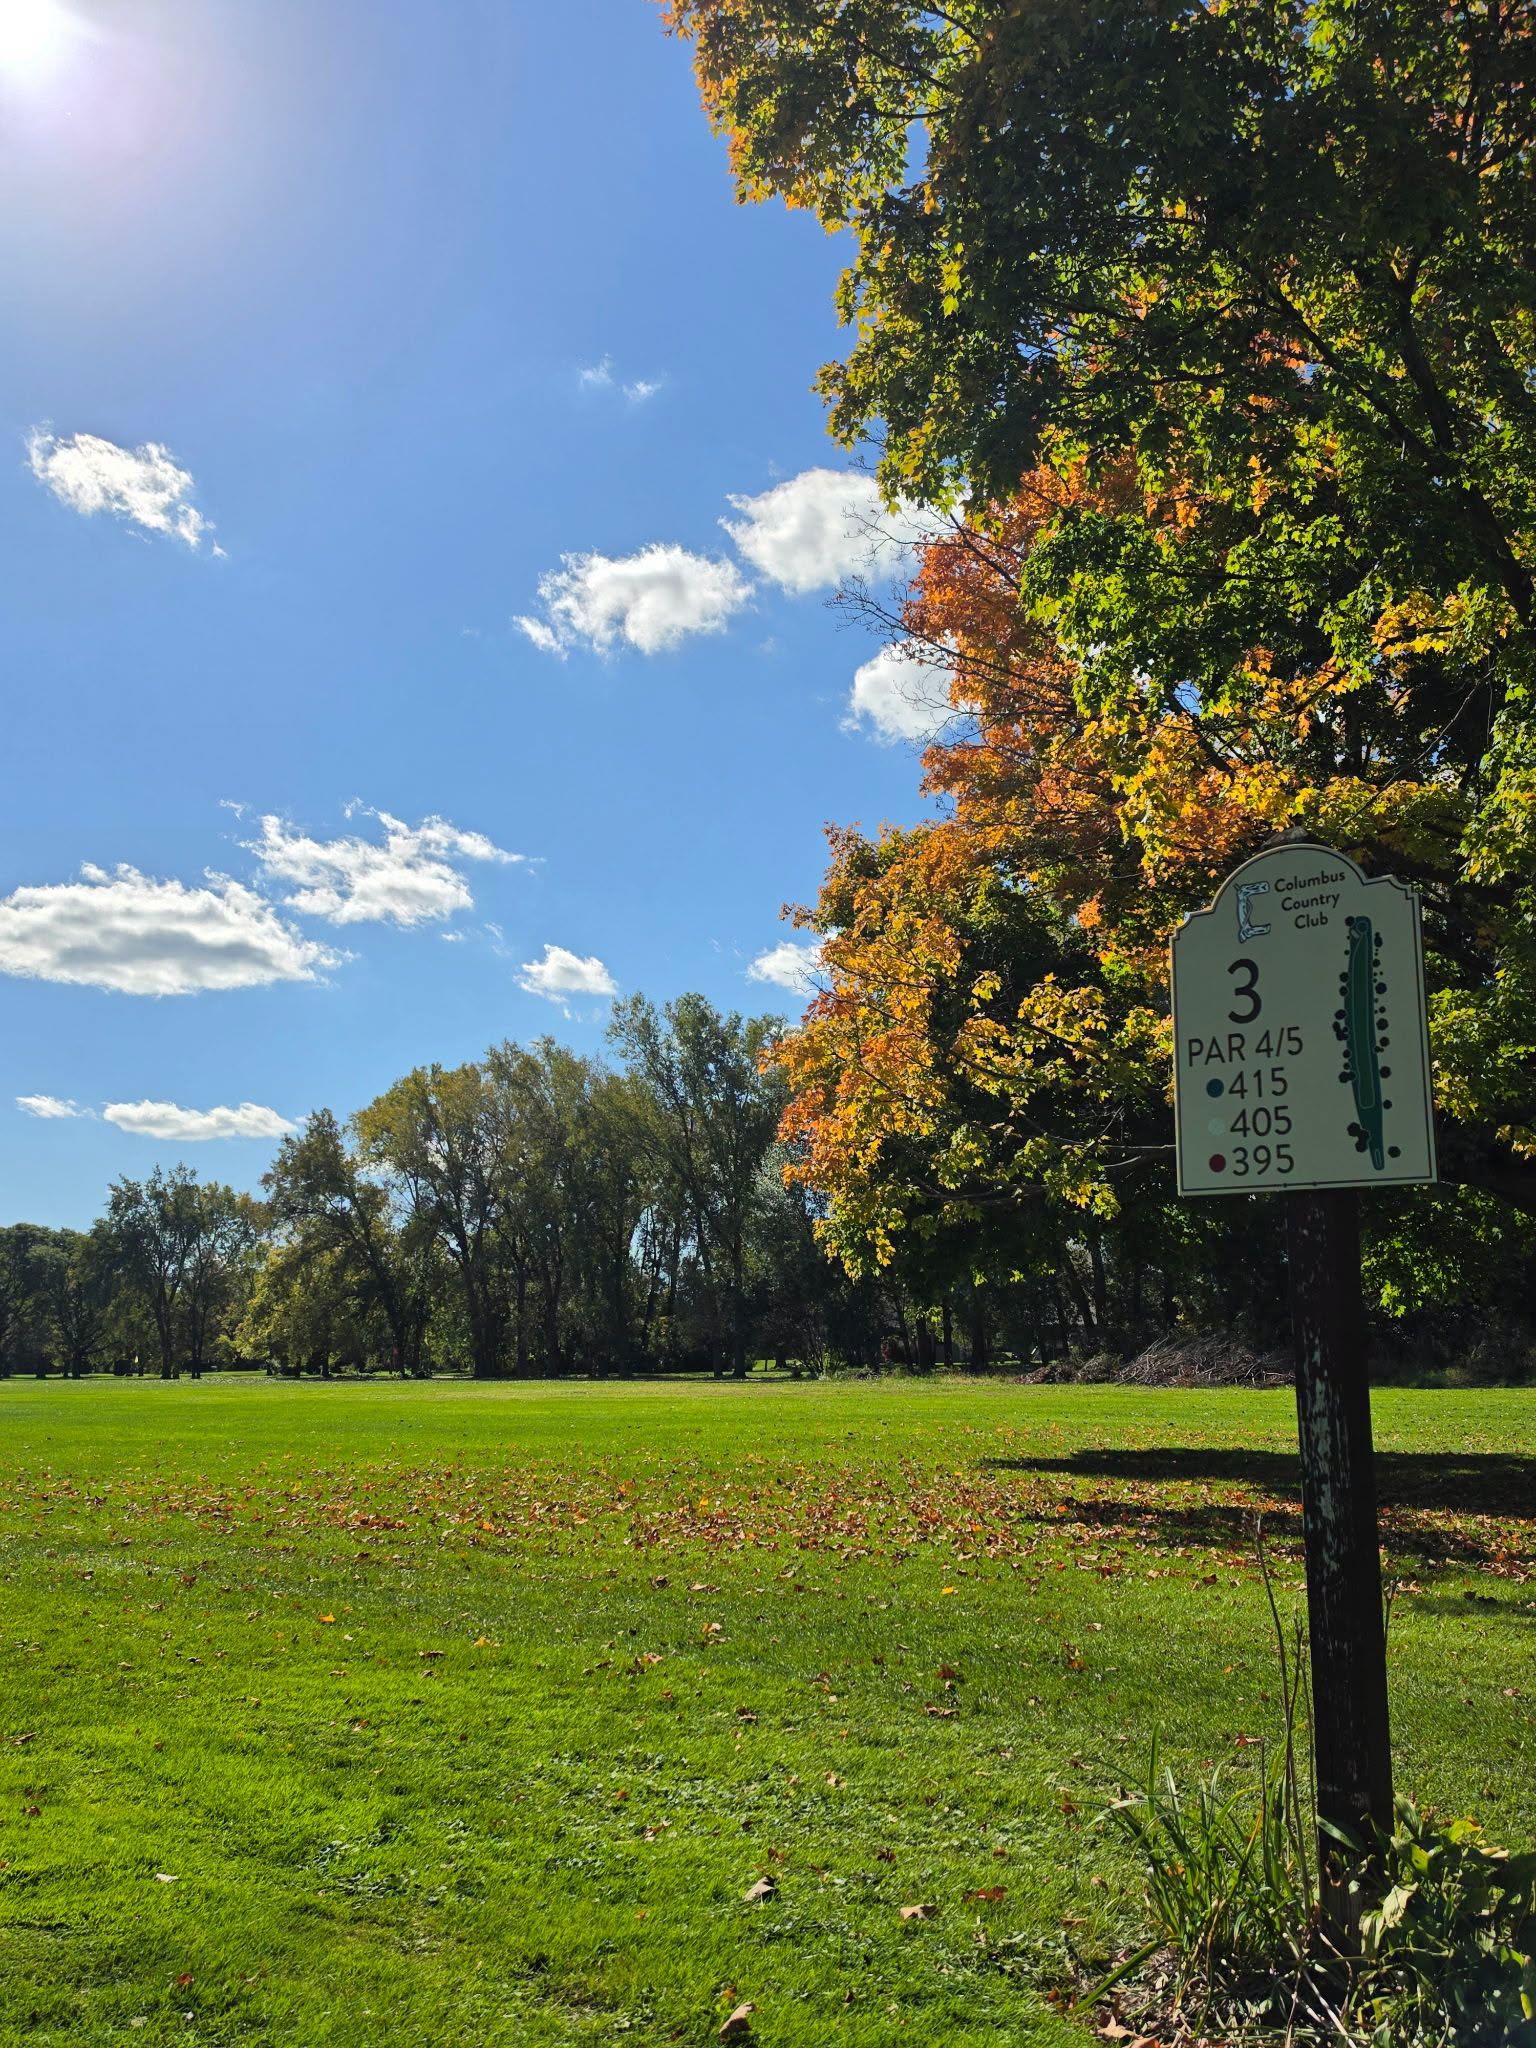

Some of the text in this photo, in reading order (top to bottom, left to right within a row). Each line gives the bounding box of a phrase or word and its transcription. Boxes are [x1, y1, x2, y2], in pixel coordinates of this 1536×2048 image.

[1274, 870, 1346, 892] Columbus
[1281, 893, 1340, 911] Country
[1294, 912, 1328, 929] Club
[1227, 958, 1262, 1024] 3
[1188, 1025, 1303, 1067] PAR 4/5
[1228, 1067, 1288, 1099] 415
[1230, 1105, 1292, 1138] 405
[1231, 1143, 1294, 1177] 395
